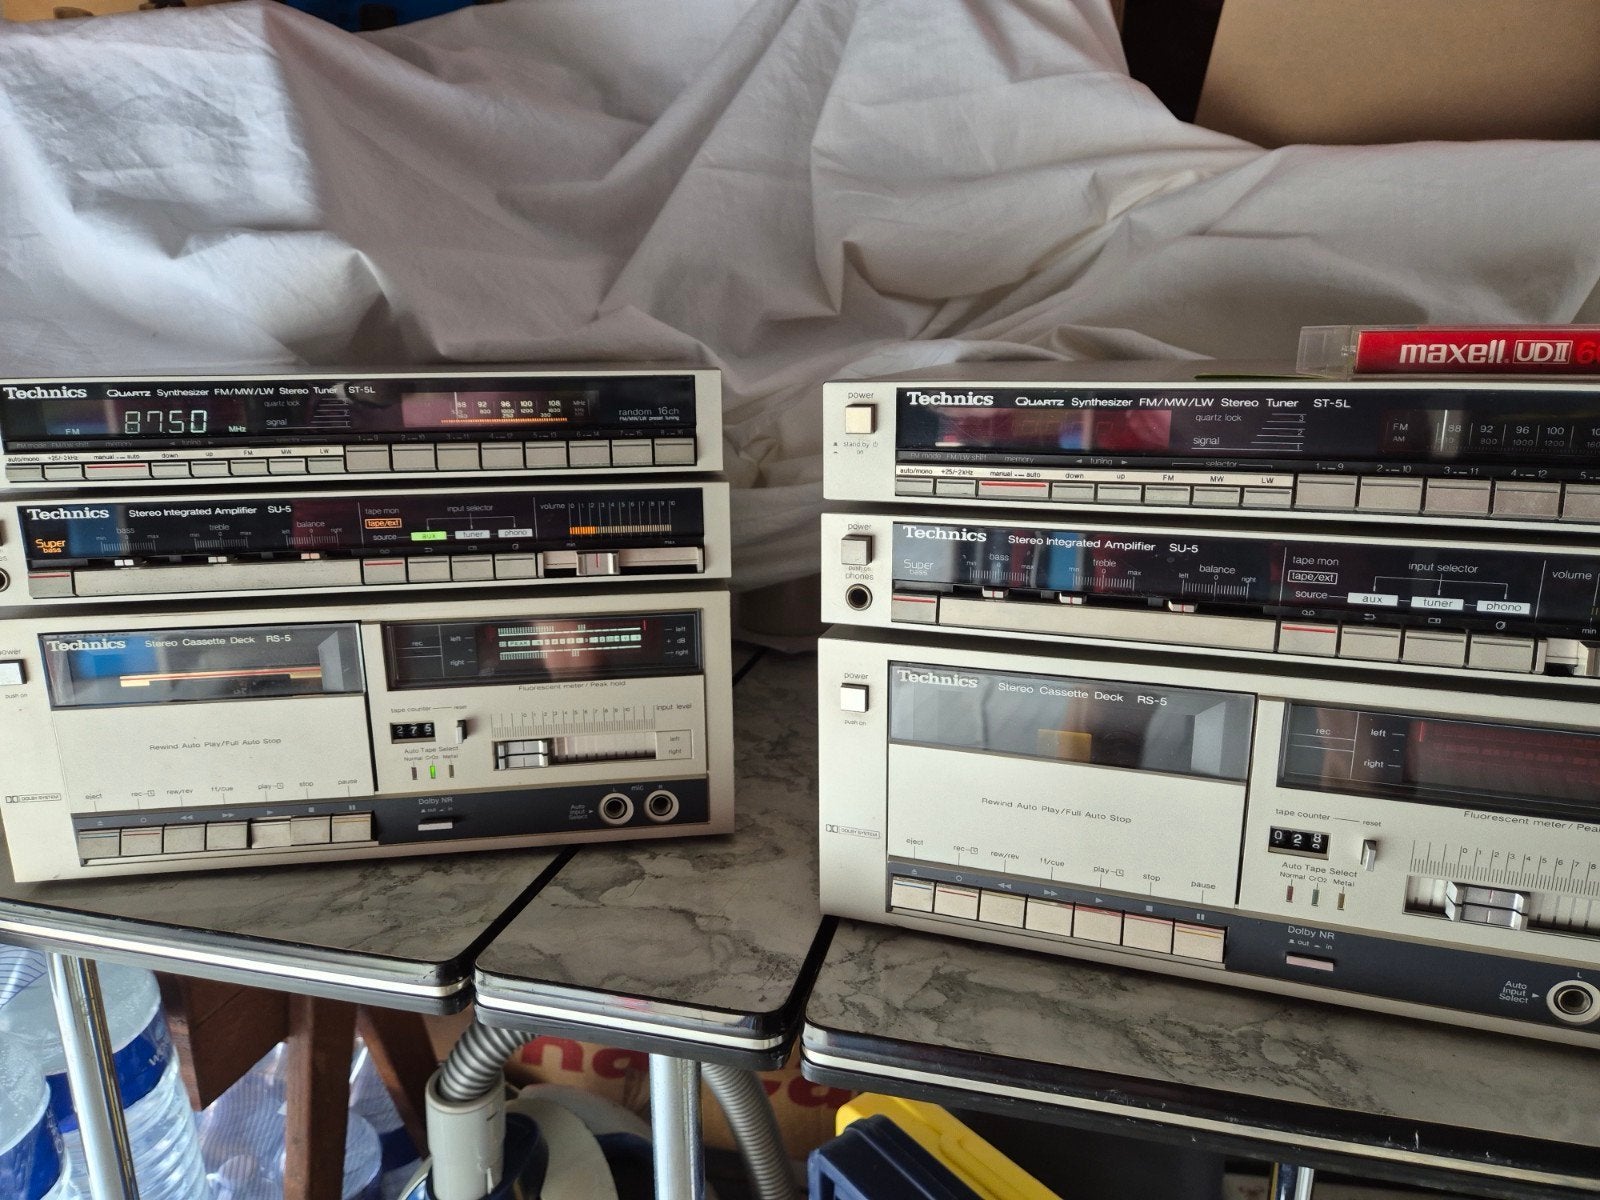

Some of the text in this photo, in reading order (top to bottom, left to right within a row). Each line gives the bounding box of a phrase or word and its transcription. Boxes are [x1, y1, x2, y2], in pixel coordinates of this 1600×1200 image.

[1399, 340, 1506, 364] maxell
[1575, 342, 1600, 364] 6
[3, 385, 88, 400] Technics
[156, 388, 210, 398] Synthesizer
[214, 387, 274, 396] FM/MW/LW
[279, 386, 309, 395] Stereo
[313, 386, 338, 395] Tuner
[348, 385, 376, 394] ST-5L
[847, 392, 875, 400] power
[520, 400, 533, 408] 100
[906, 391, 994, 406] Technics
[1015, 397, 1351, 408] QUARTZ Synthesizer FM/MW/LW Stereo Tuner ST-5L
[618, 407, 652, 416] random
[266, 418, 287, 427] signal
[1195, 413, 1242, 422] quartz lock
[65, 428, 80, 436] FM
[228, 425, 247, 433] MHz
[1393, 423, 1565, 436] FM 92 96 100
[1192, 436, 1220, 446] signal
[1090, 457, 1113, 466] tuning
[1065, 472, 1085, 480] down
[1162, 474, 1175, 482] FM
[1209, 475, 1225, 483] MW
[128, 505, 292, 518] Stereo Integrated Amplifier SU-5
[540, 502, 566, 510] volume
[27, 507, 110, 521] Technics
[296, 520, 326, 529] balance
[847, 523, 872, 531] power
[462, 530, 483, 539] tuner
[504, 529, 528, 538] phono
[902, 525, 987, 542] Technics
[35, 539, 66, 551] Super
[1008, 534, 1199, 553] Stereo Integrated Amplifier SU-5
[989, 553, 1010, 562] bass
[1093, 558, 1117, 568] treble
[1292, 555, 1339, 566] tape mon
[903, 559, 935, 571] Super
[1199, 564, 1236, 575] balance
[1408, 562, 1479, 574] input selector
[845, 572, 874, 582] phones
[909, 568, 928, 576] bass
[1291, 571, 1334, 583] tape/ext
[1552, 570, 1592, 580] volume
[1295, 589, 1328, 599] source
[1362, 594, 1383, 604] aux
[1423, 598, 1453, 608] tuner
[1486, 601, 1522, 613] phono
[46, 638, 127, 652] Technics
[144, 634, 292, 648] Stereo Cassette Deck RS-5
[844, 672, 869, 682] power
[897, 669, 978, 688] Technics
[997, 682, 1168, 706] Stereo Cassette Deck RS-5
[1315, 727, 1331, 736] rec
[1370, 728, 1386, 738] left
[149, 743, 179, 751] Rewind
[203, 740, 239, 749] Play/Full
[242, 738, 261, 746] Auto
[263, 738, 281, 746] Stop
[1363, 758, 1384, 770] right
[981, 797, 1132, 824] Rewind Auto Play/Full Auto Stop
[1275, 808, 1382, 827] tape counter reset
[1463, 810, 1530, 826] Fluorescent
[1533, 819, 1567, 830] meter
[906, 836, 924, 847] eject
[953, 844, 965, 852] rec
[990, 850, 1020, 861] rew/rev
[1093, 865, 1110, 876] play
[1281, 861, 1358, 879] Auto Tape Select
[1142, 872, 1161, 883] stop
[1279, 871, 1356, 888] Normal Metal
[1190, 879, 1216, 891] pause
[1287, 925, 1336, 941] Dolby NR
[1505, 980, 1528, 990] Auto
[1503, 986, 1526, 997] Input
[1499, 993, 1529, 1004] Select
